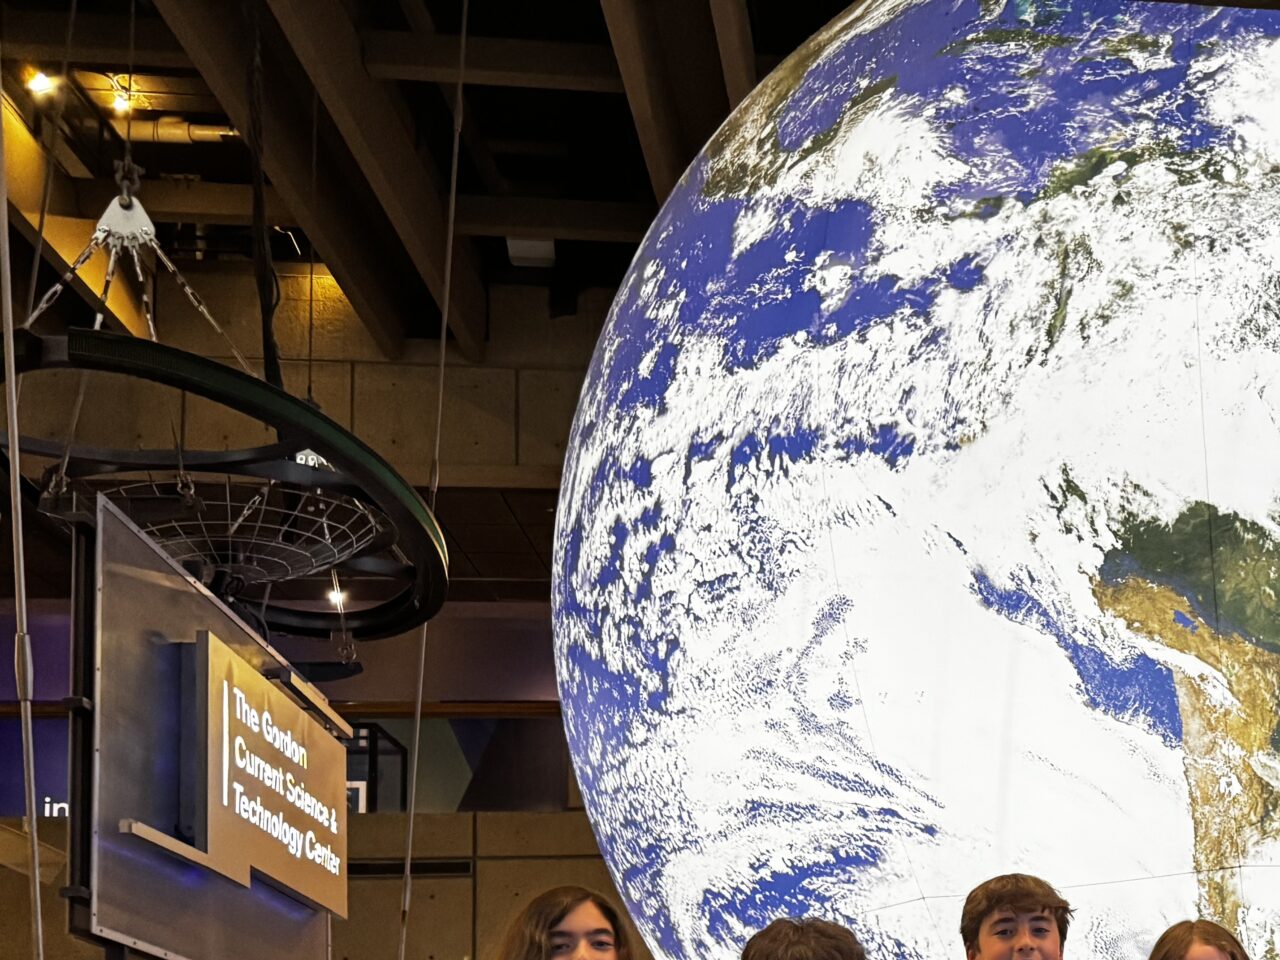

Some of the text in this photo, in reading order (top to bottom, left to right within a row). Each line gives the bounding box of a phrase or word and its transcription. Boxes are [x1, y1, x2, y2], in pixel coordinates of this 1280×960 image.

[233, 686, 307, 770] The Gordon
[232, 781, 340, 876] Technology Center
[234, 735, 338, 834] Current Science &
